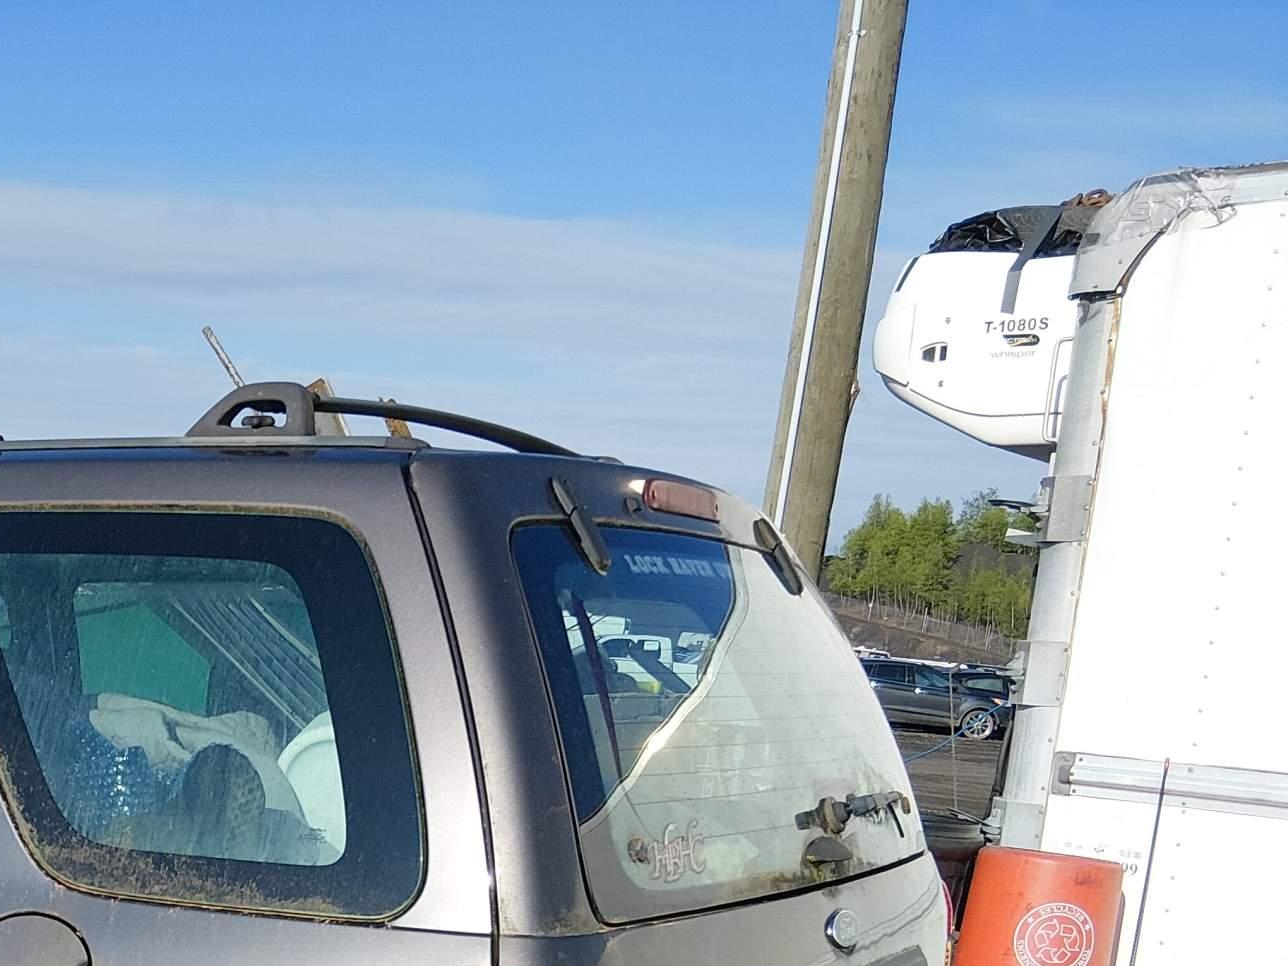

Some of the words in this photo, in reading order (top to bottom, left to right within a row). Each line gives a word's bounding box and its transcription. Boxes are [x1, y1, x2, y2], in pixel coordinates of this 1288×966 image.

[984, 316, 1049, 334] T-1080S
[990, 350, 1037, 360] whisper
[624, 554, 669, 574] LOCK
[667, 557, 716, 577] HAVEN
[1039, 904, 1085, 922] RECYCLES
